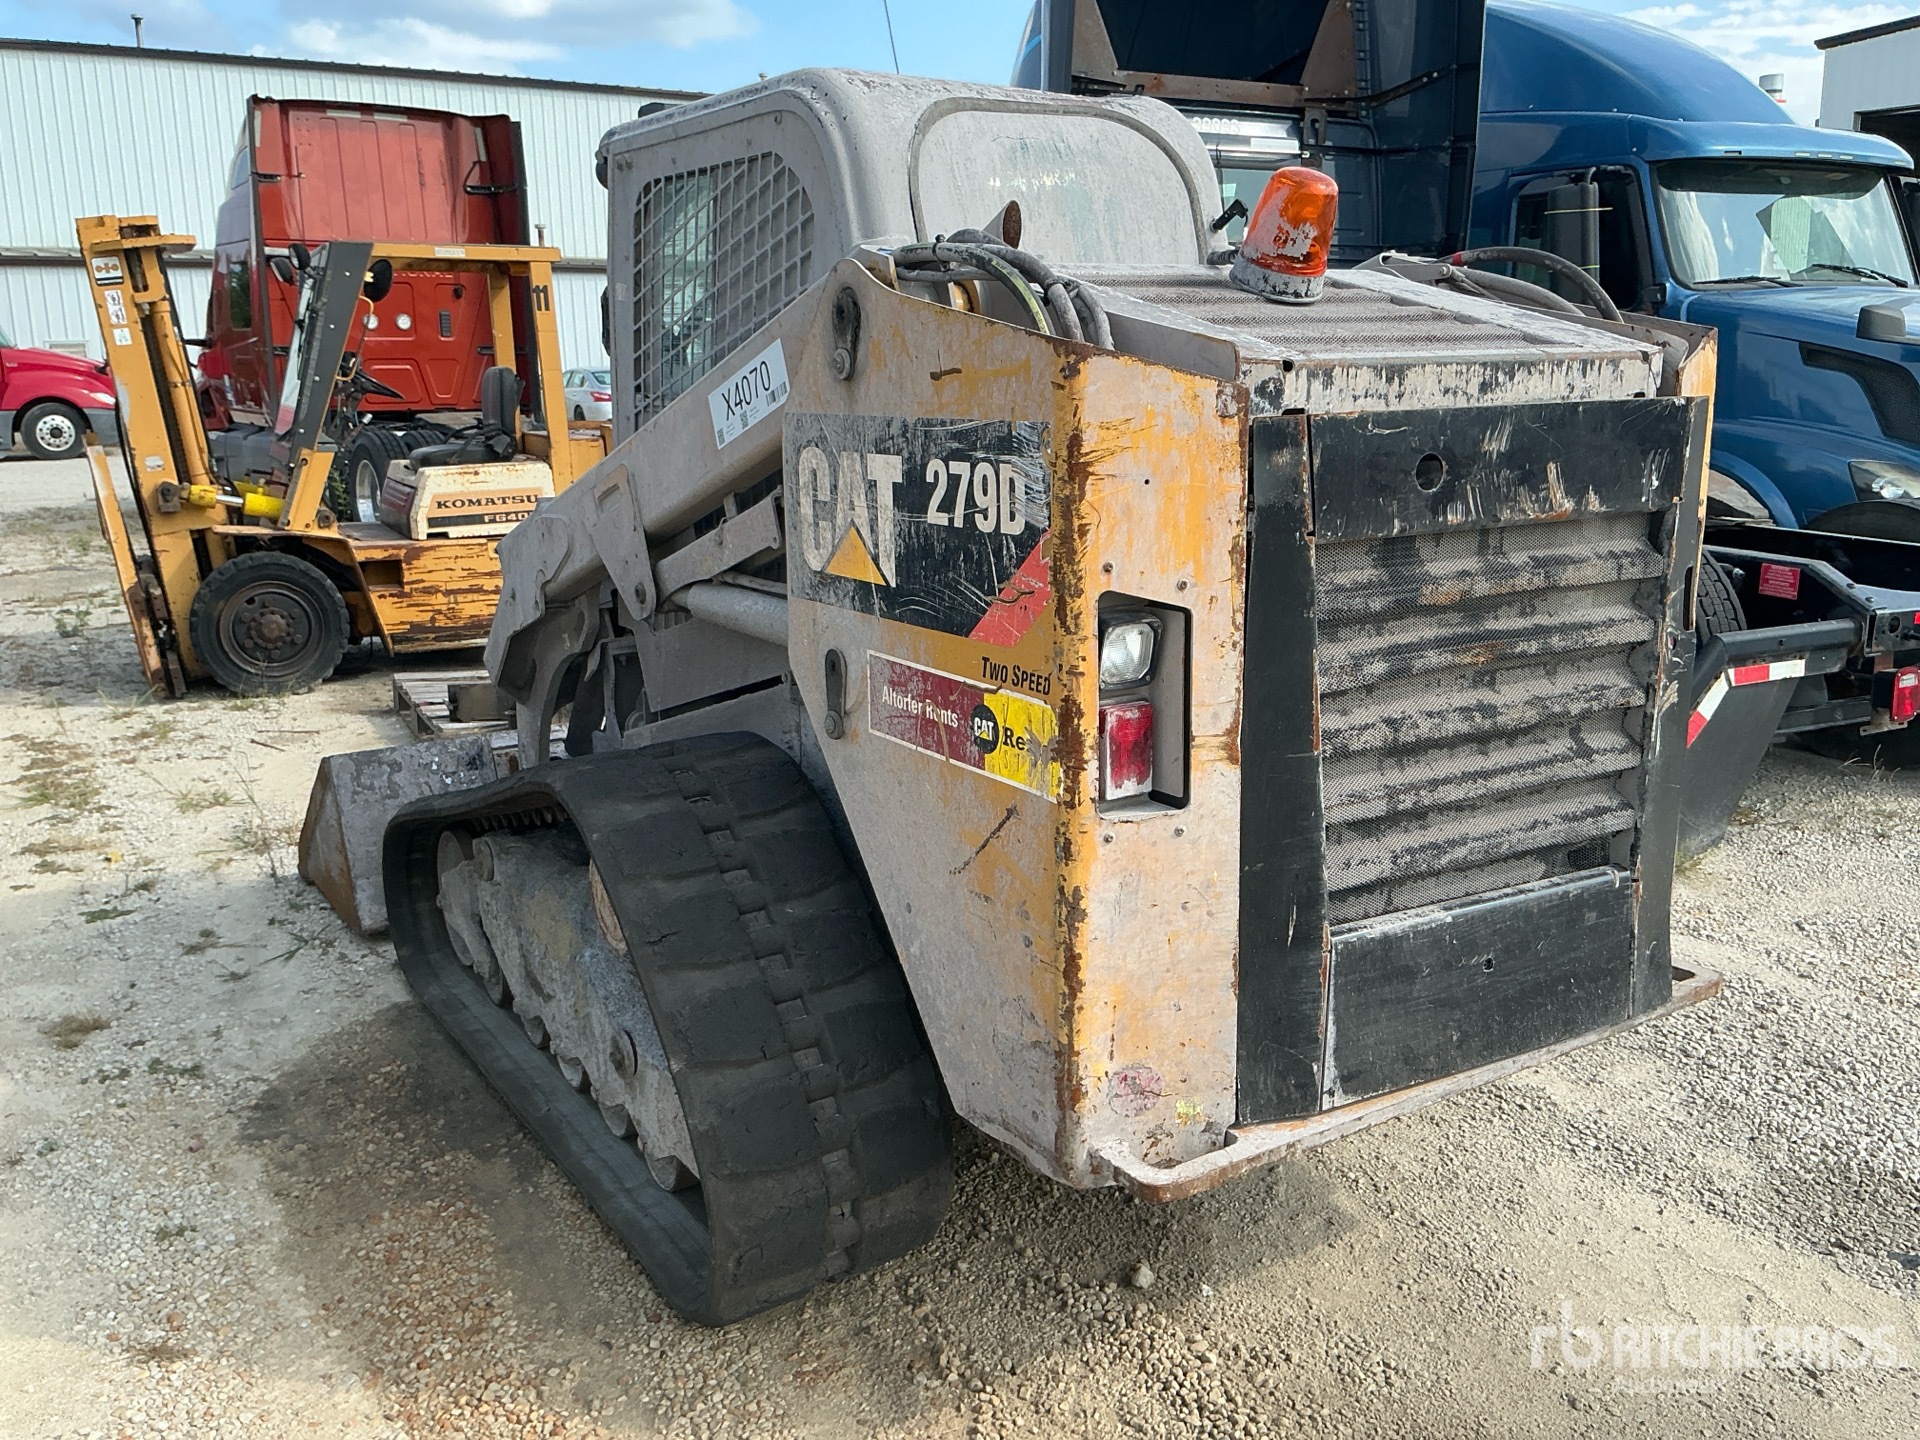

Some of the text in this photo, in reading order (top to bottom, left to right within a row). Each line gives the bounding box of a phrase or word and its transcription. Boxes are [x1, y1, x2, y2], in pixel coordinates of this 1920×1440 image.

[532, 285, 550, 311] 11
[721, 360, 771, 422] X4070
[436, 494, 539, 510] KOMATSU
[925, 458, 1026, 535] 279D
[484, 511, 533, 523] FG40
[798, 446, 903, 588] CAT
[881, 685, 923, 715] Altorfer
[973, 716, 994, 741] CAT
